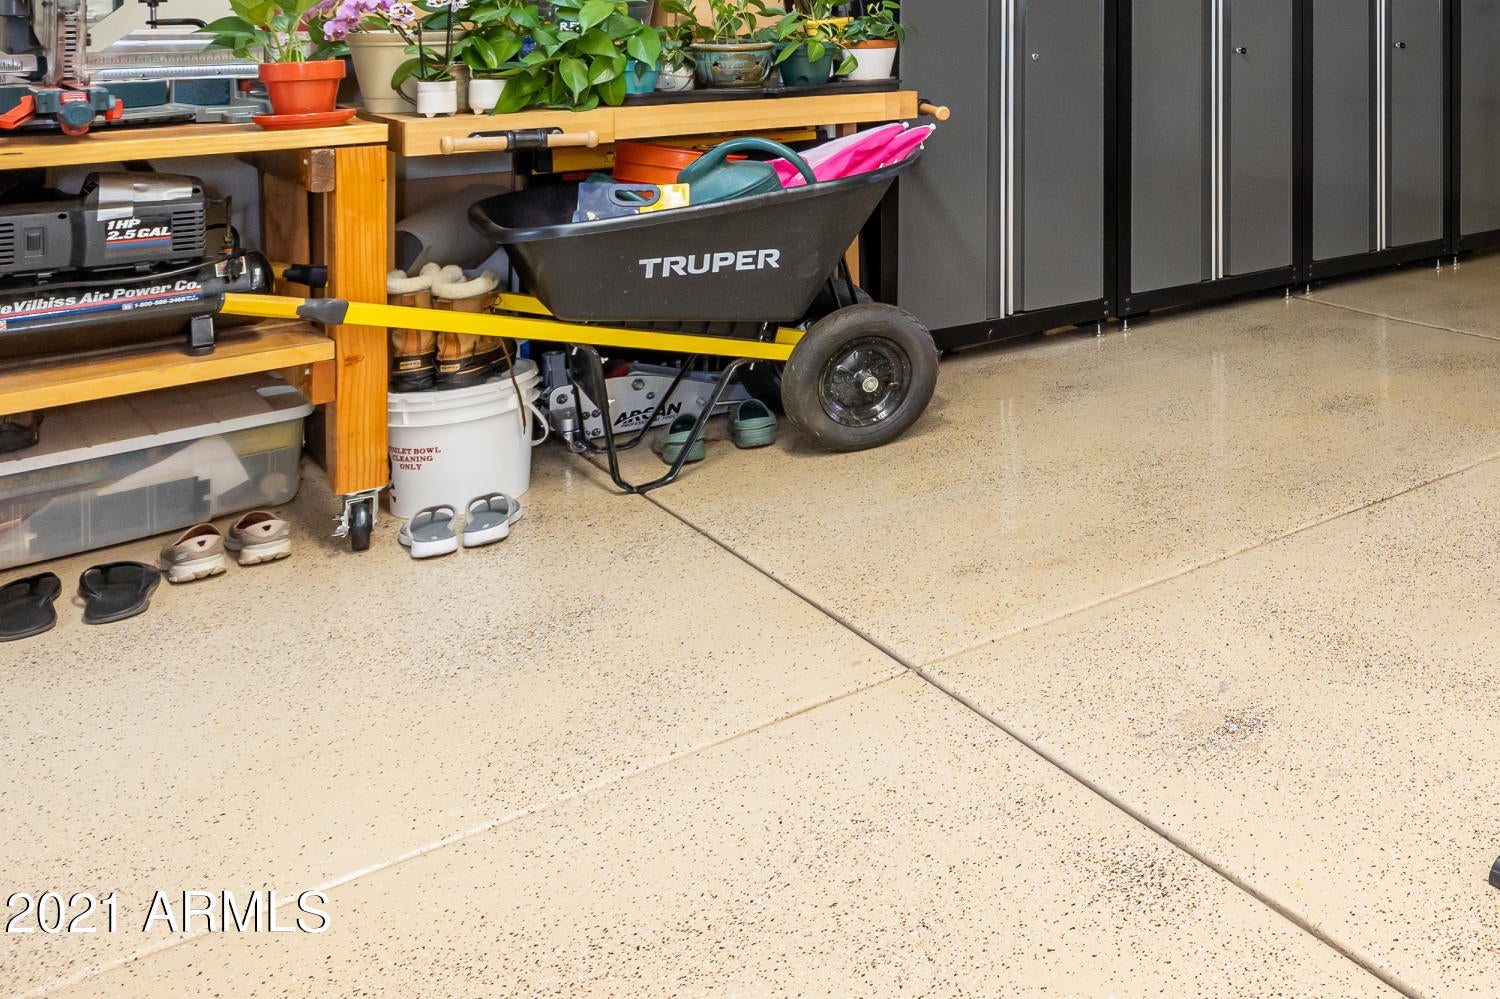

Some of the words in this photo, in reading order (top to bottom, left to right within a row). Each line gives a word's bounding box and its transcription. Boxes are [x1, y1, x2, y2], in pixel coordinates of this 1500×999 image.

[106, 230, 136, 241] 2.5
[137, 225, 172, 238] GAL
[639, 249, 780, 279] TRUPER
[0, 296, 77, 315] eVilbiss
[79, 291, 110, 304] Air
[112, 283, 172, 300] Power
[174, 280, 202, 291] Co.
[413, 447, 441, 455] BOWL
[392, 454, 433, 462] CLEANING
[399, 463, 422, 471] ONLY
